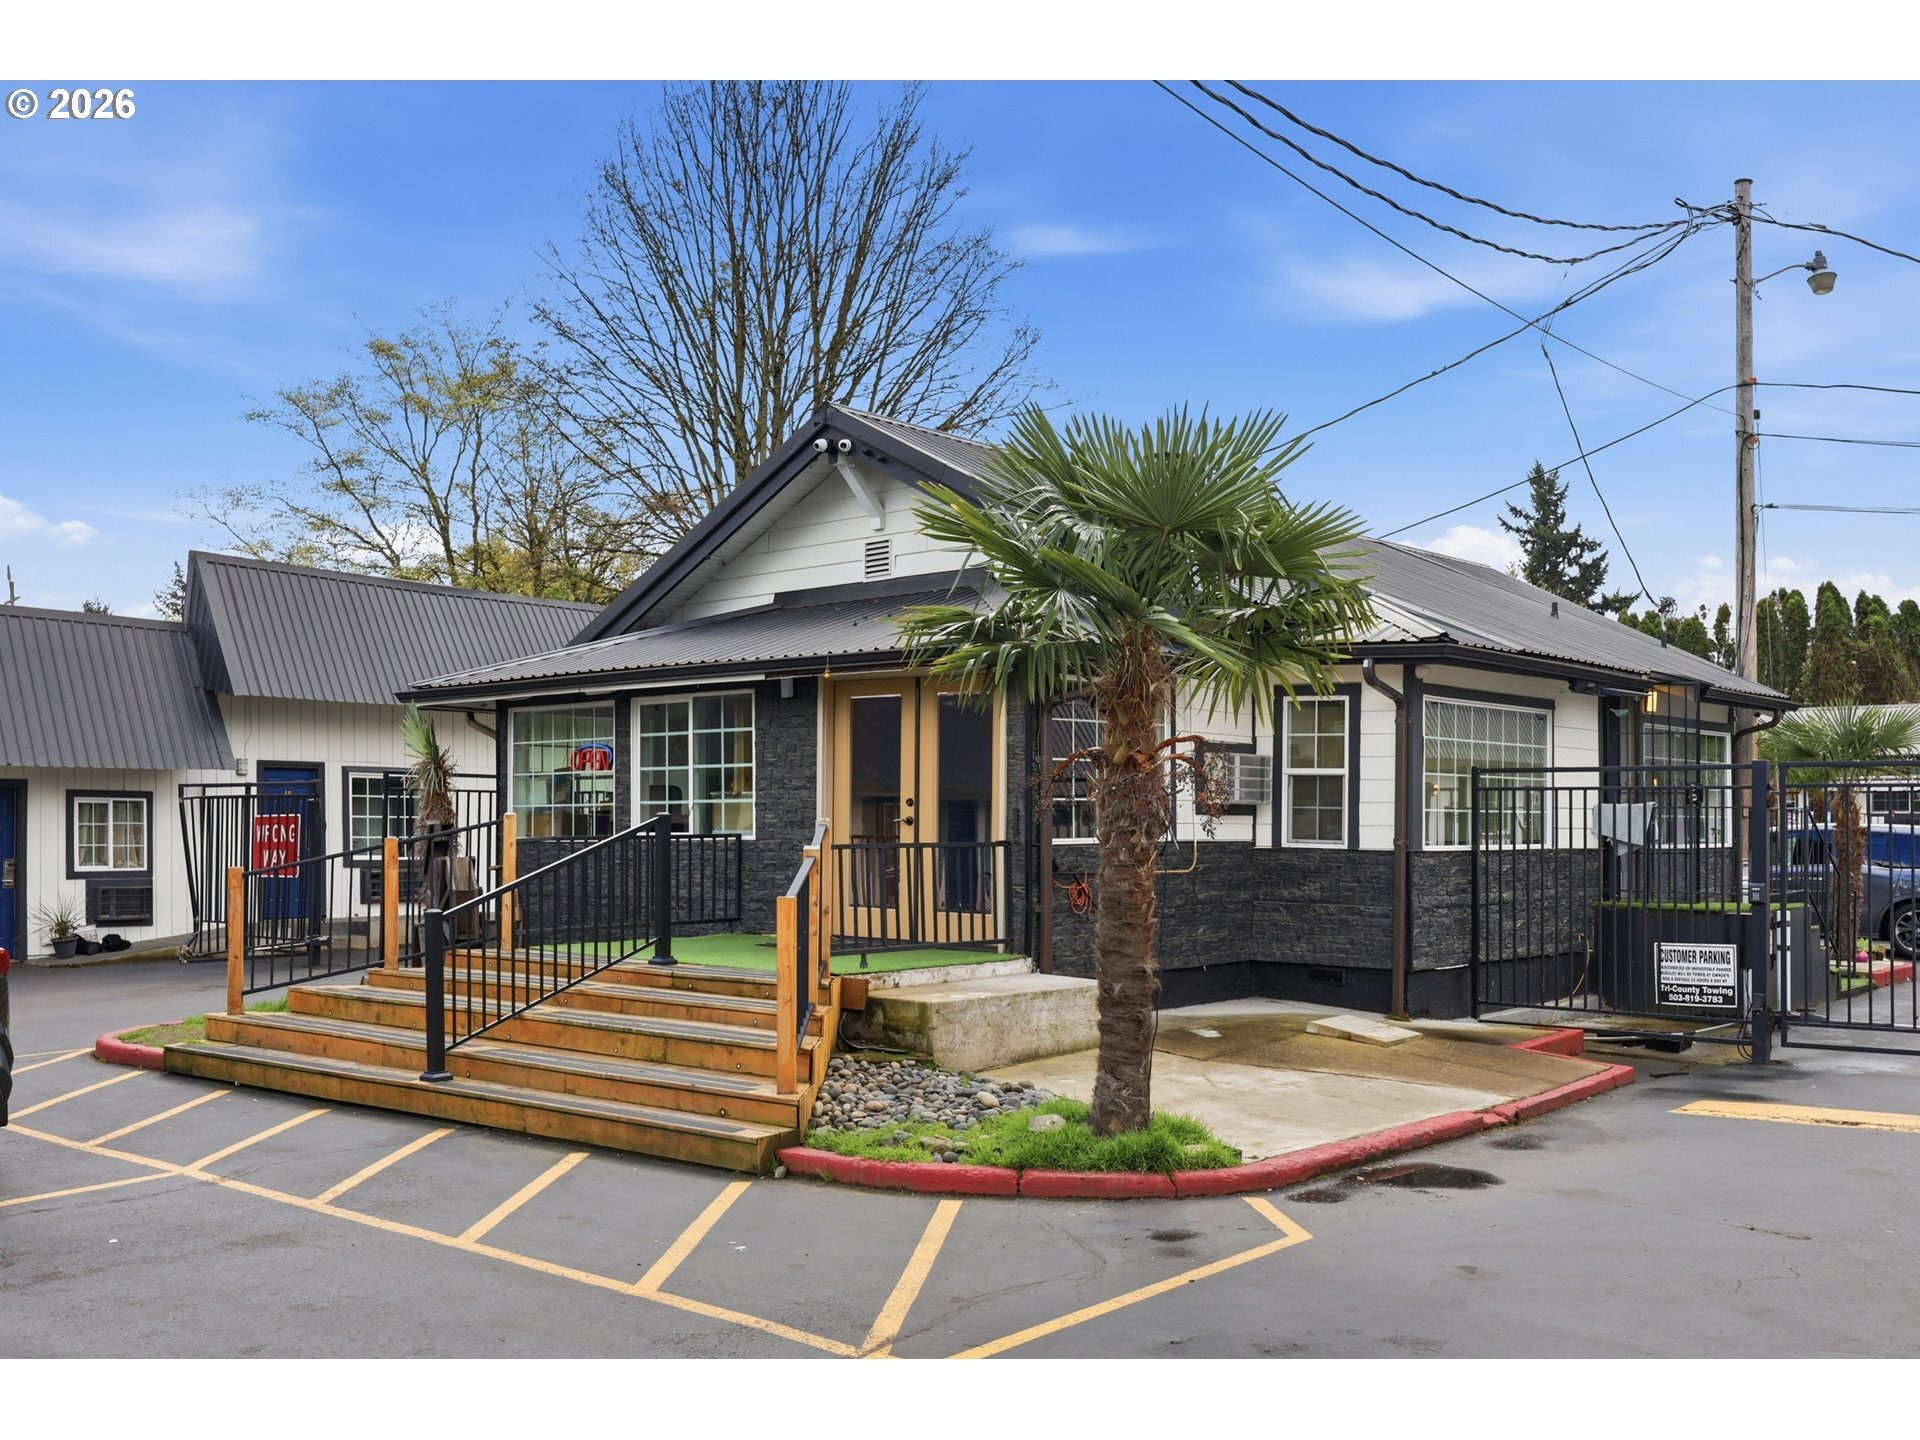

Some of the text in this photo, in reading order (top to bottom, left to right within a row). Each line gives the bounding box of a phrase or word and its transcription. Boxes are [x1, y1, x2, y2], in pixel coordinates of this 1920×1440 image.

[568, 748, 609, 771] OPEN
[263, 849, 286, 868] WAY
[1660, 949, 1731, 964] CUSTOMER PARKING
[1661, 985, 1733, 996] Tri-County Towing
[1669, 994, 1723, 1003] 503-819-3783
